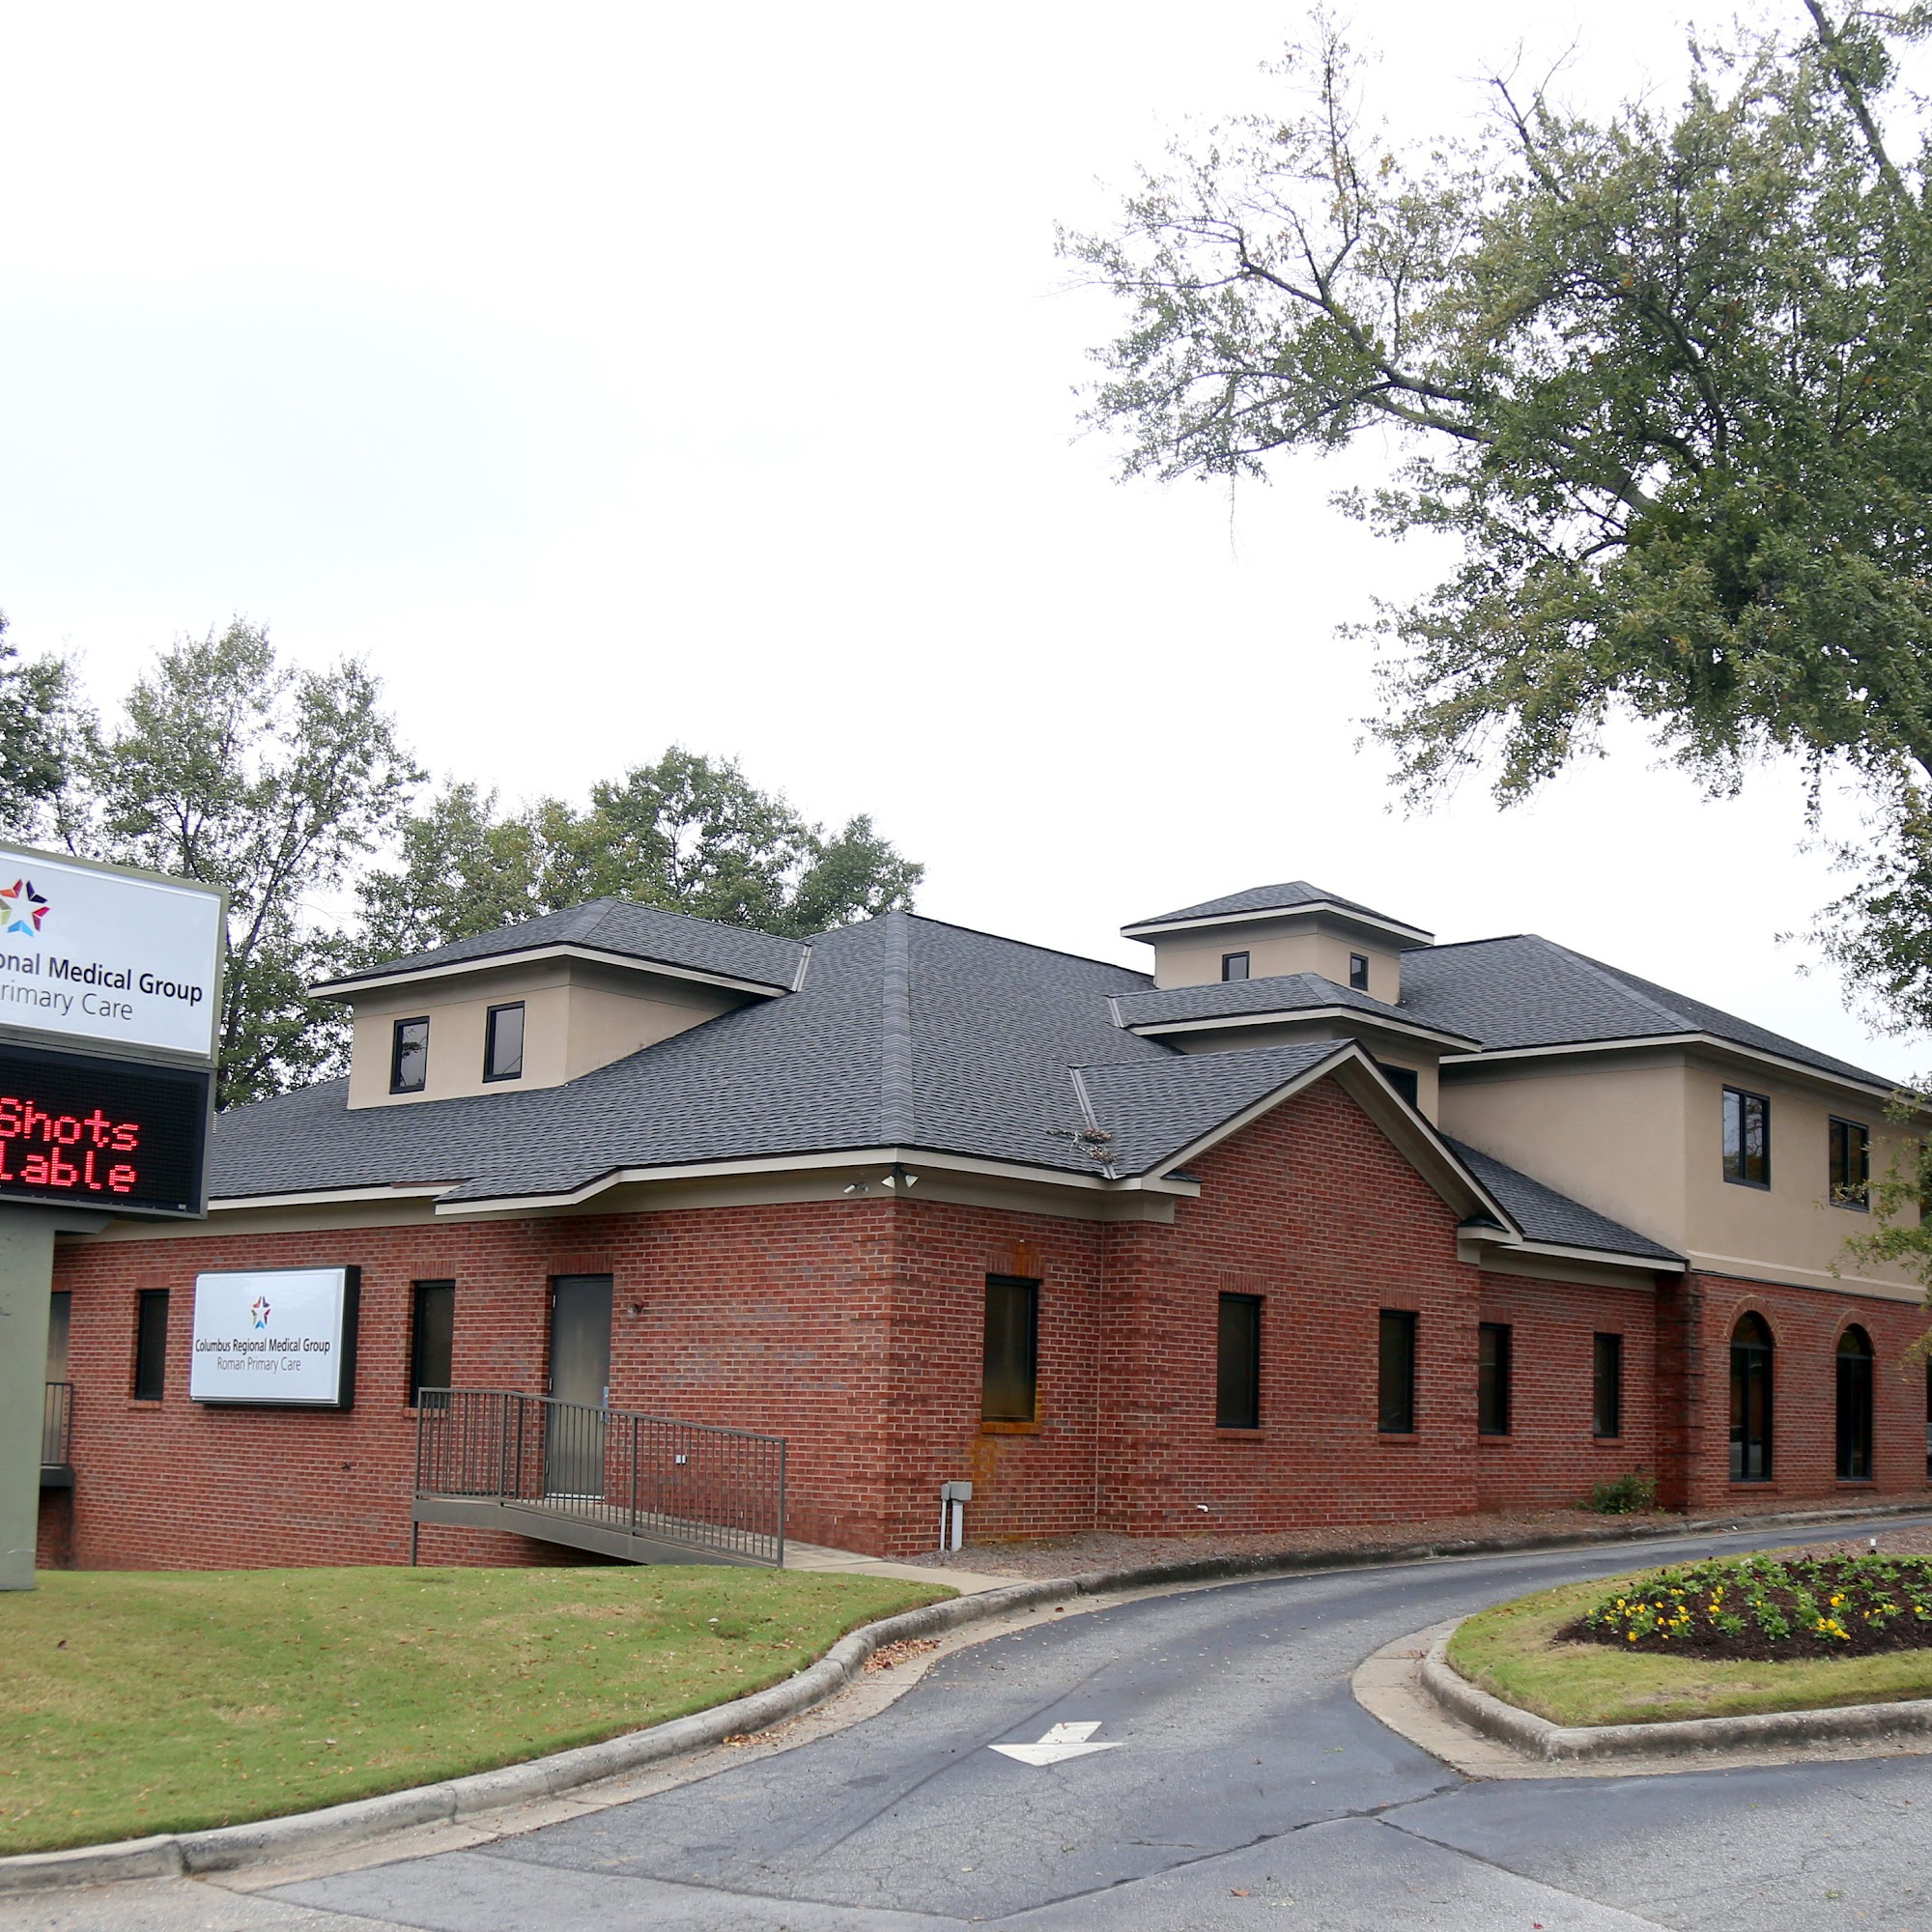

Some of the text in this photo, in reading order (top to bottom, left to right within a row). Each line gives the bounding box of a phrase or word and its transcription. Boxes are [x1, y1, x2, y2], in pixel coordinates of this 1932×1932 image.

[48, 956, 131, 990] Medical
[139, 973, 203, 1007] Group
[82, 993, 133, 1020] Care
[0, 1097, 139, 1151] Shots
[195, 1337, 330, 1355] Columbus Regional Medical Group
[217, 1356, 301, 1375] Roman Primary Care
